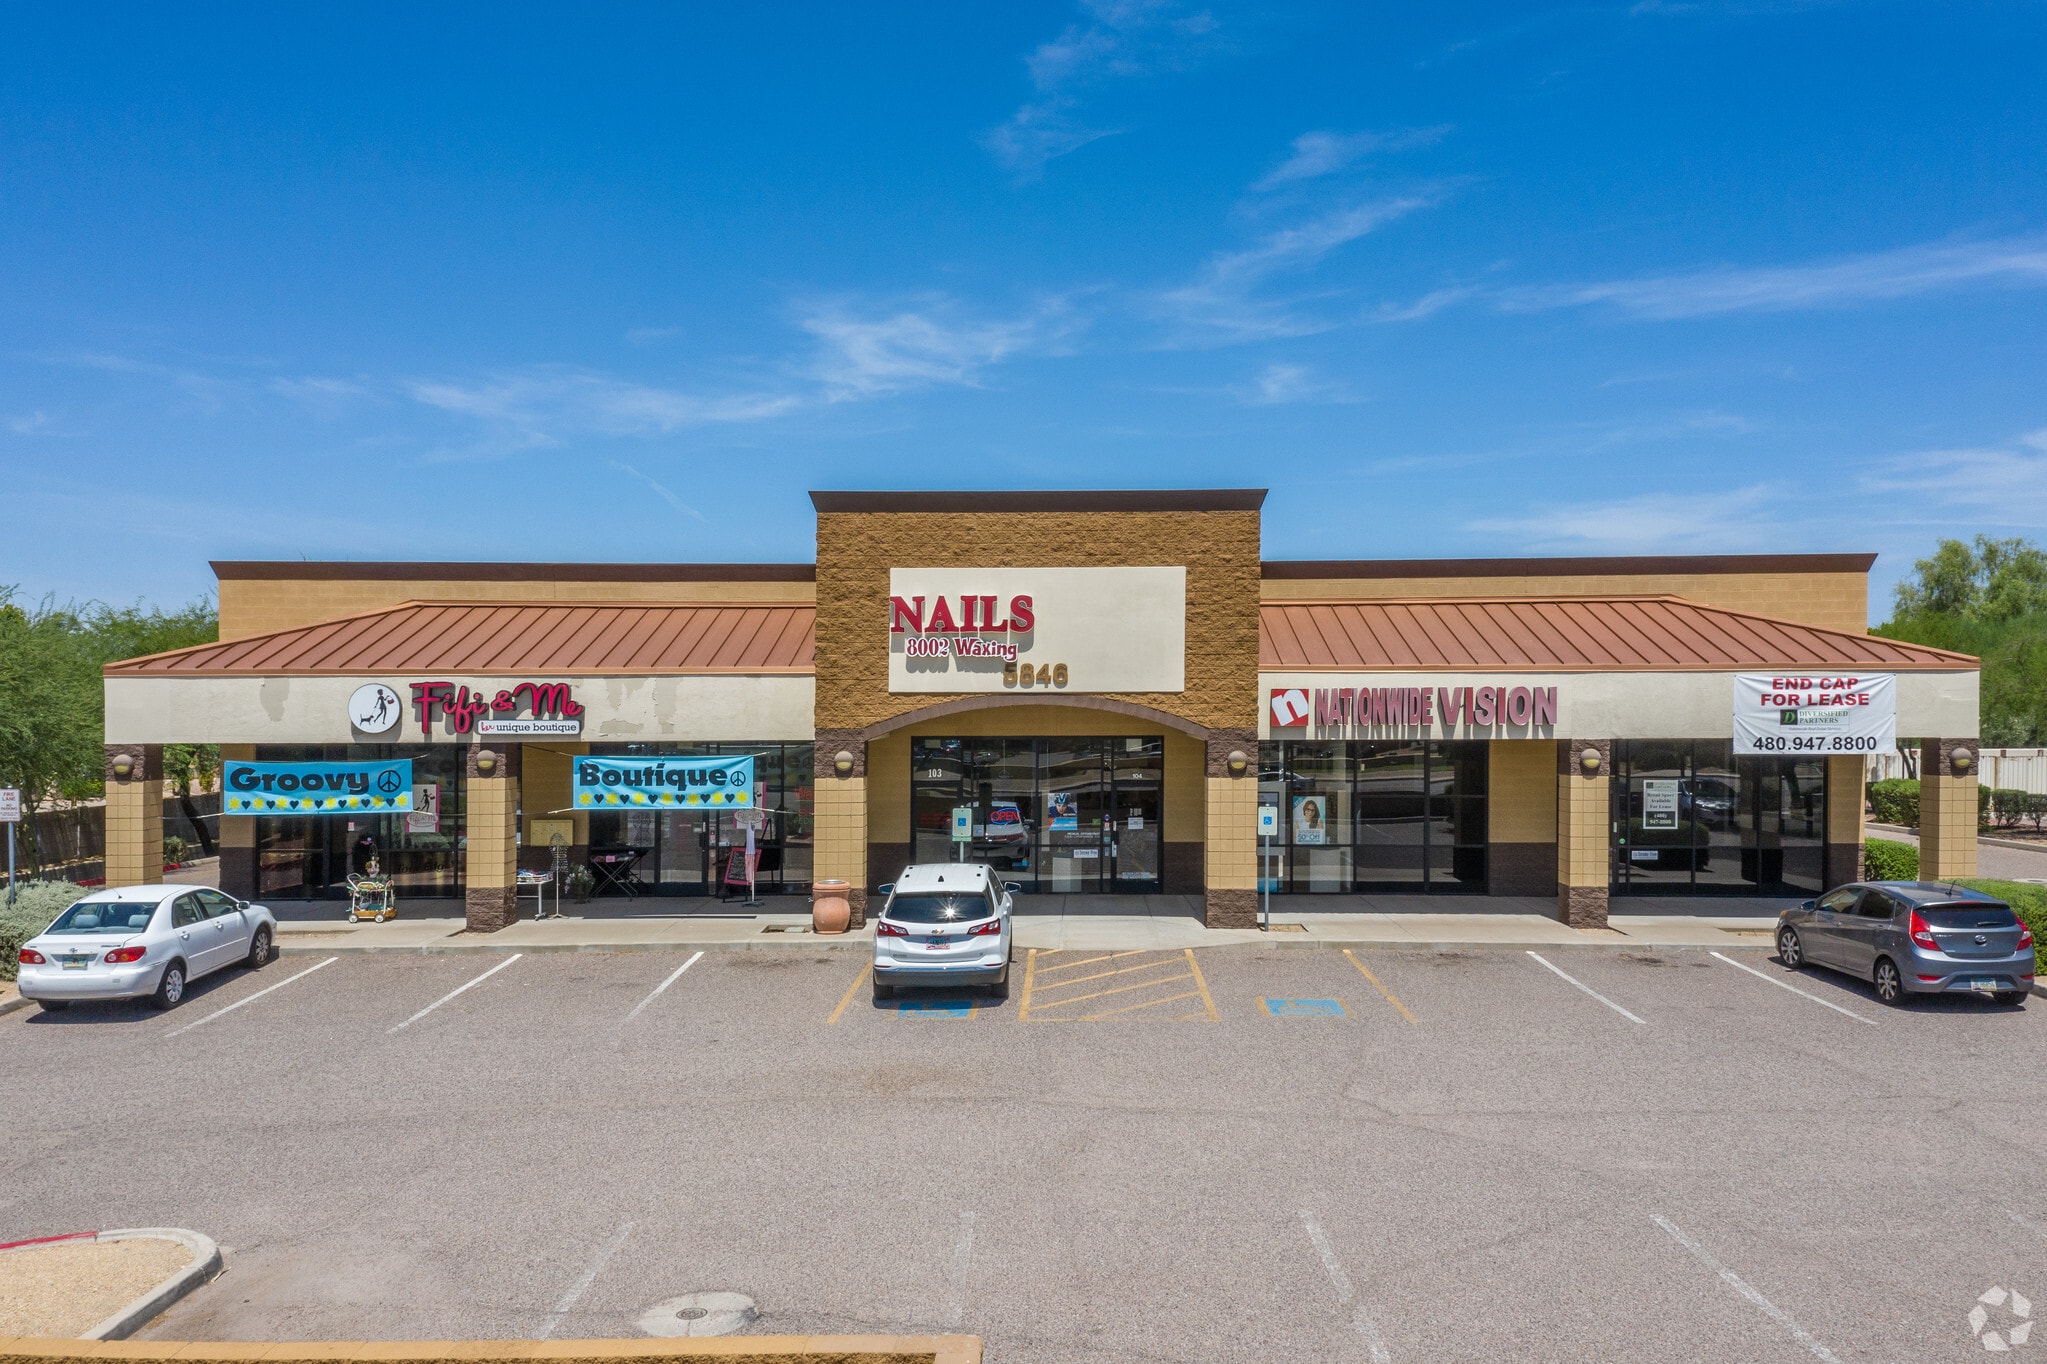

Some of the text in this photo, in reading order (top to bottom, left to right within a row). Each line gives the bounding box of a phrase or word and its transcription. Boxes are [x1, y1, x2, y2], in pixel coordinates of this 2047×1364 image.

[890, 595, 1035, 633] NAILS
[906, 637, 1019, 662] 8002 Waxing
[1003, 663, 1069, 685] 5846
[1772, 677, 1859, 690] END CAP
[409, 681, 584, 734] Fifi & Me
[1315, 686, 1558, 726] NATIONWIDE VISION
[1760, 693, 1870, 706] FOR LEASE
[496, 723, 531, 732] unique
[533, 721, 577, 732] boutique
[1752, 736, 1877, 750] 480.947.8800
[230, 767, 369, 795] Groovy
[579, 763, 728, 791] Boutique
[928, 768, 942, 778] 103
[990, 811, 1019, 821] OPEN
